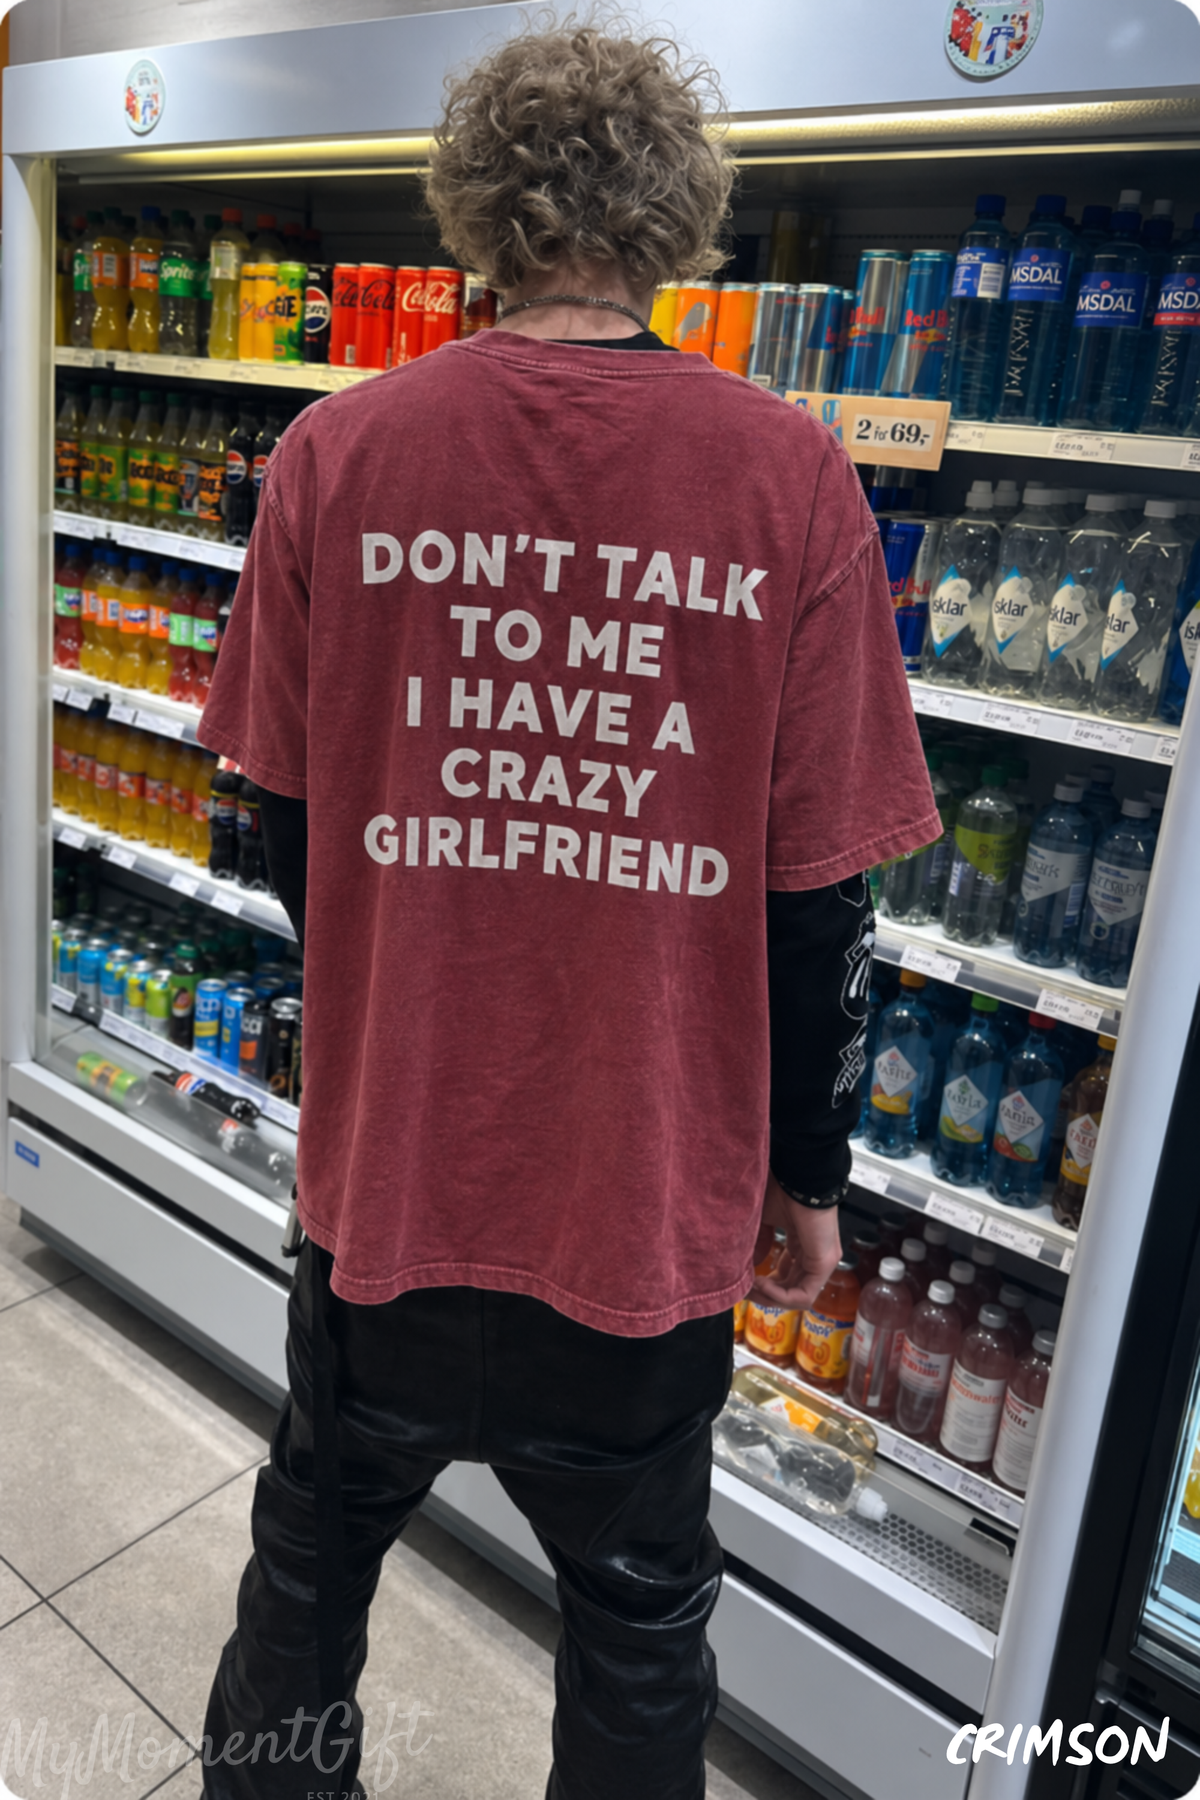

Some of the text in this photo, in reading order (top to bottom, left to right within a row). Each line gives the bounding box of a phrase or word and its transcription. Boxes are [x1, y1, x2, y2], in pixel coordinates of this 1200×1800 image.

[856, 418, 872, 440] 2
[362, 529, 769, 621] DON'T TALK
[450, 605, 664, 678] TO ME
[406, 676, 696, 754] I HAVE A
[441, 747, 658, 818] CRAZY
[363, 813, 729, 897] GIRLFRIEND
